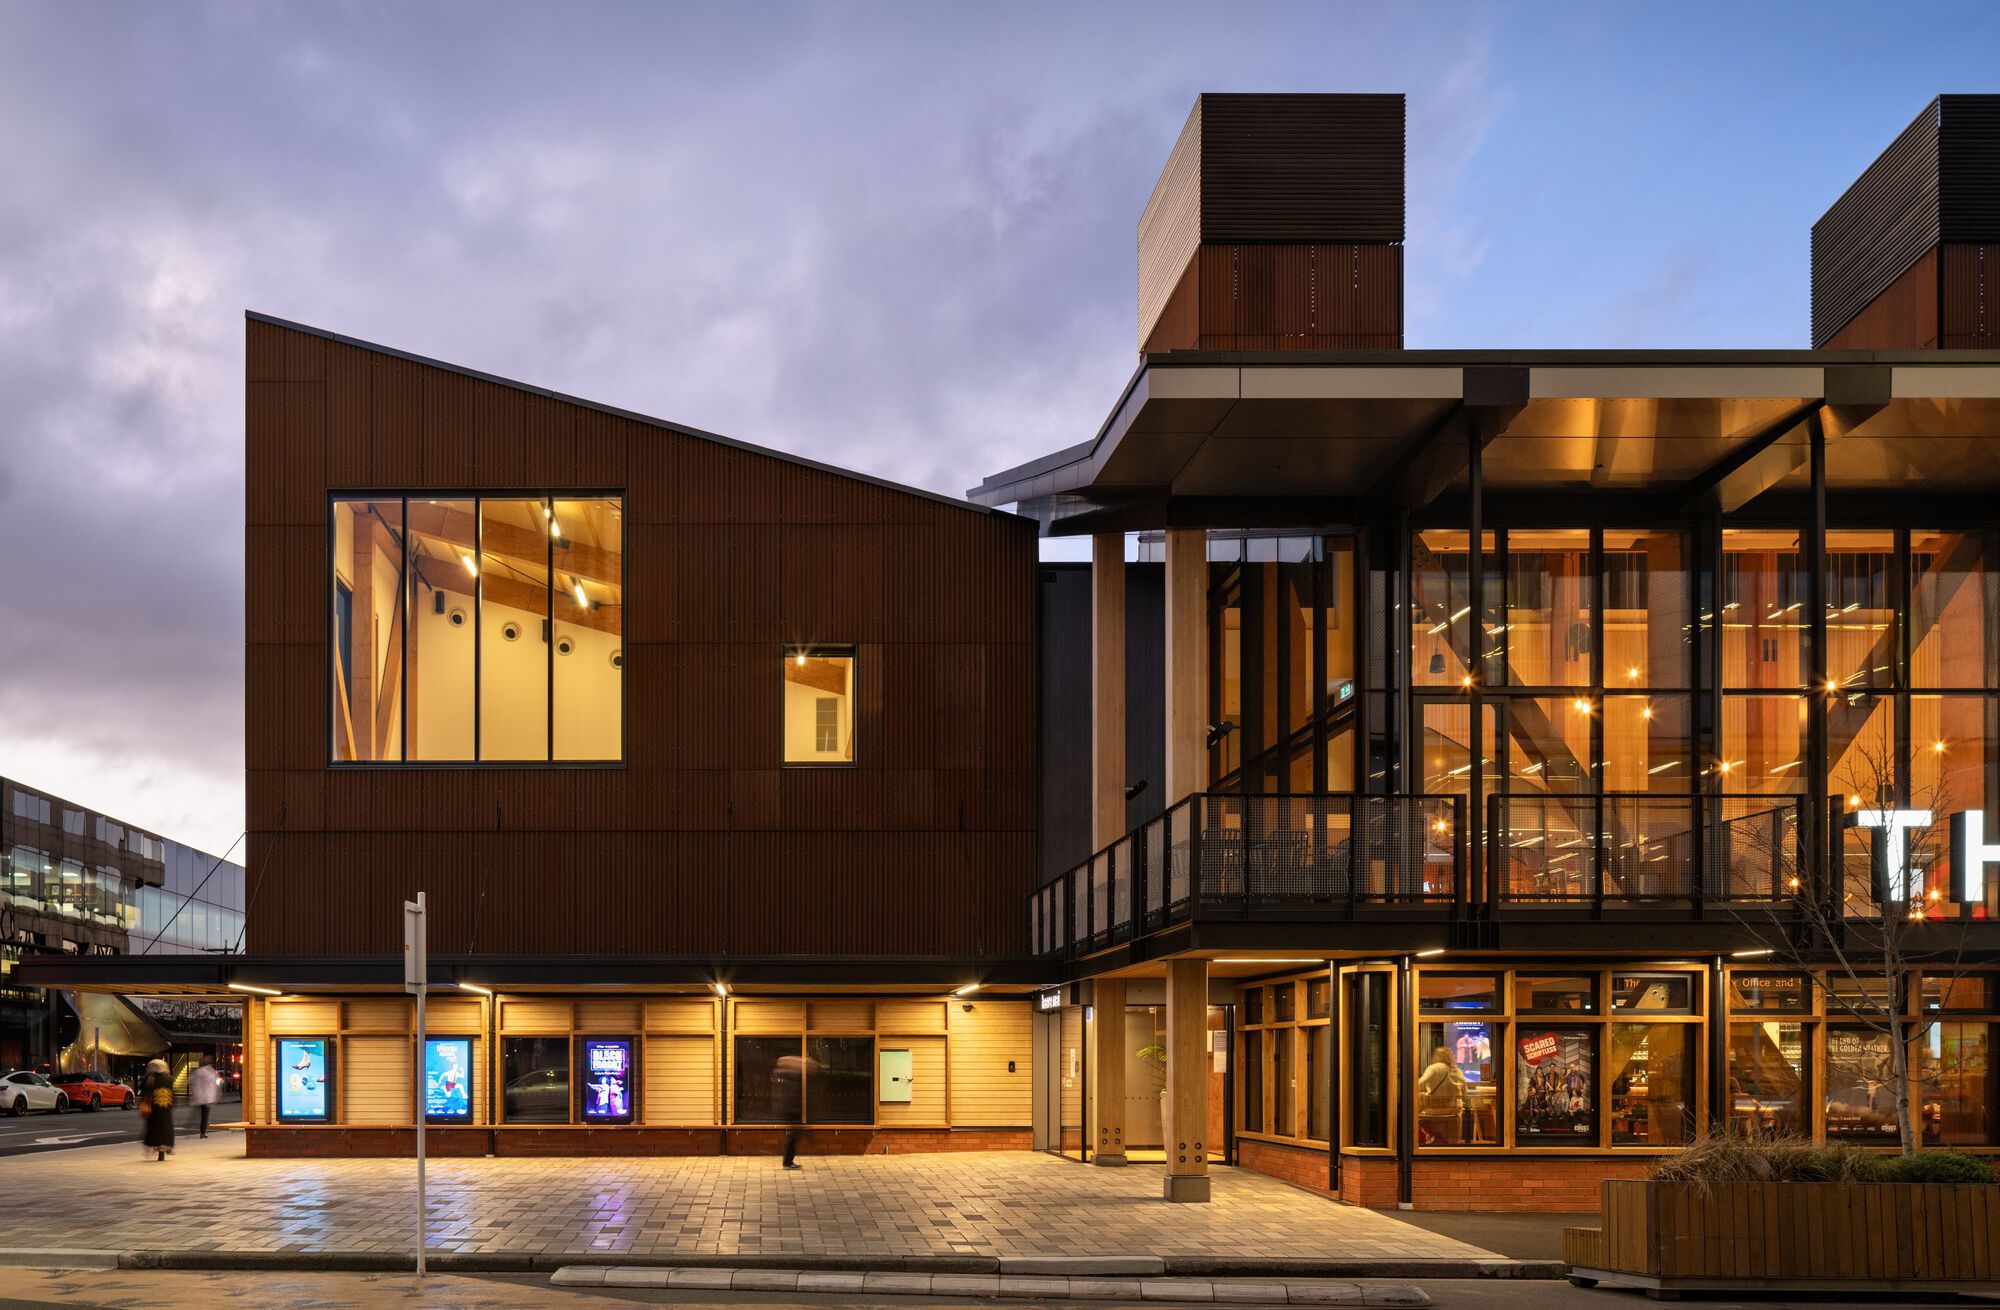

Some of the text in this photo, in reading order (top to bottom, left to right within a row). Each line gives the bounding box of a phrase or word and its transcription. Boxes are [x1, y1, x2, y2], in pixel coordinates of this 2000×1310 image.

[1742, 978, 1770, 987] Office
[1775, 978, 1793, 987] and
[1524, 1037, 1555, 1053] SCARED
[1839, 1037, 1851, 1045] END
[1852, 1037, 1860, 1045] OF
[1526, 1045, 1557, 1060] SCRIPTLESS
[1839, 1044, 1862, 1053] GOLDEN
